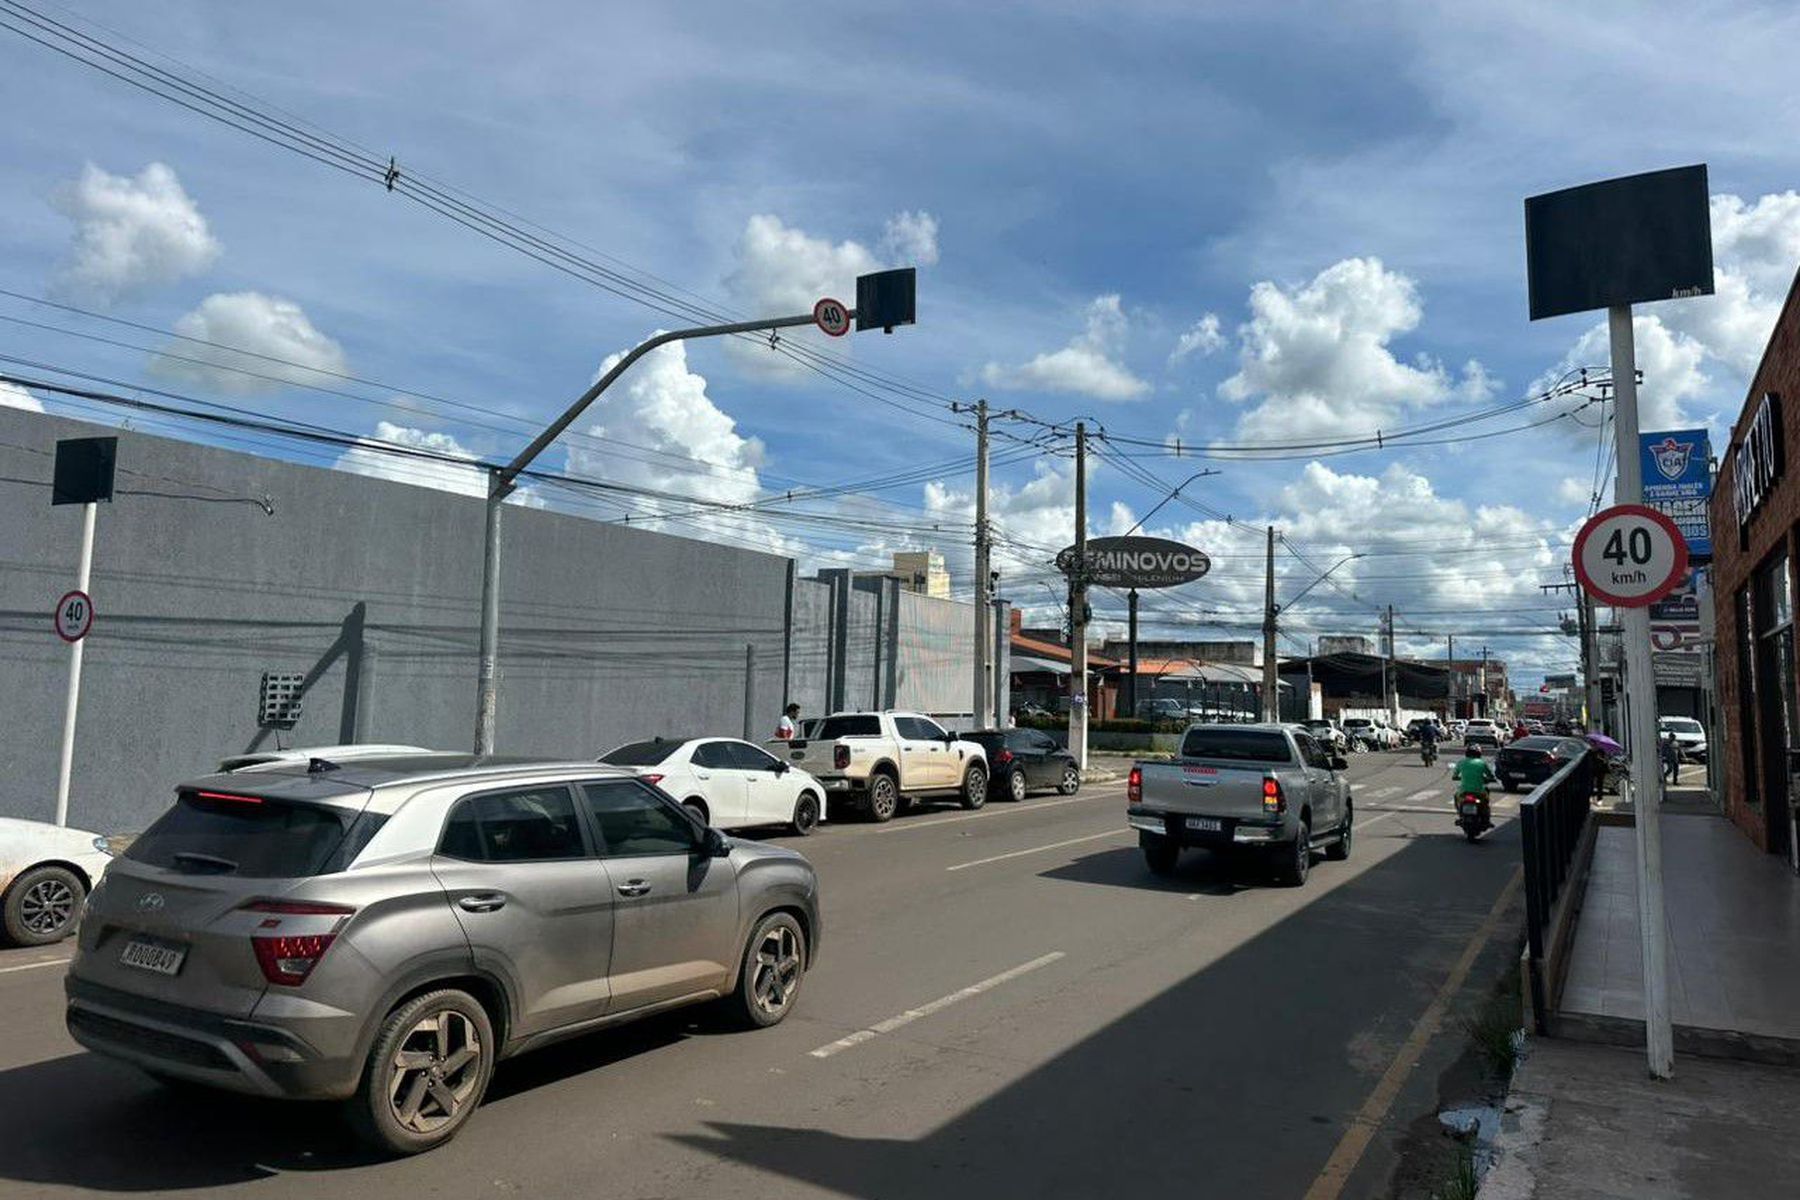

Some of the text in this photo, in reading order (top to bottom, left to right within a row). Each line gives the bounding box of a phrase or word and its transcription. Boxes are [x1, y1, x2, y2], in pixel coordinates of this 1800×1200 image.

[823, 306, 841, 325] 40
[1602, 526, 1652, 567] 40
[1611, 570, 1647, 585] km/h
[65, 600, 83, 621] 40
